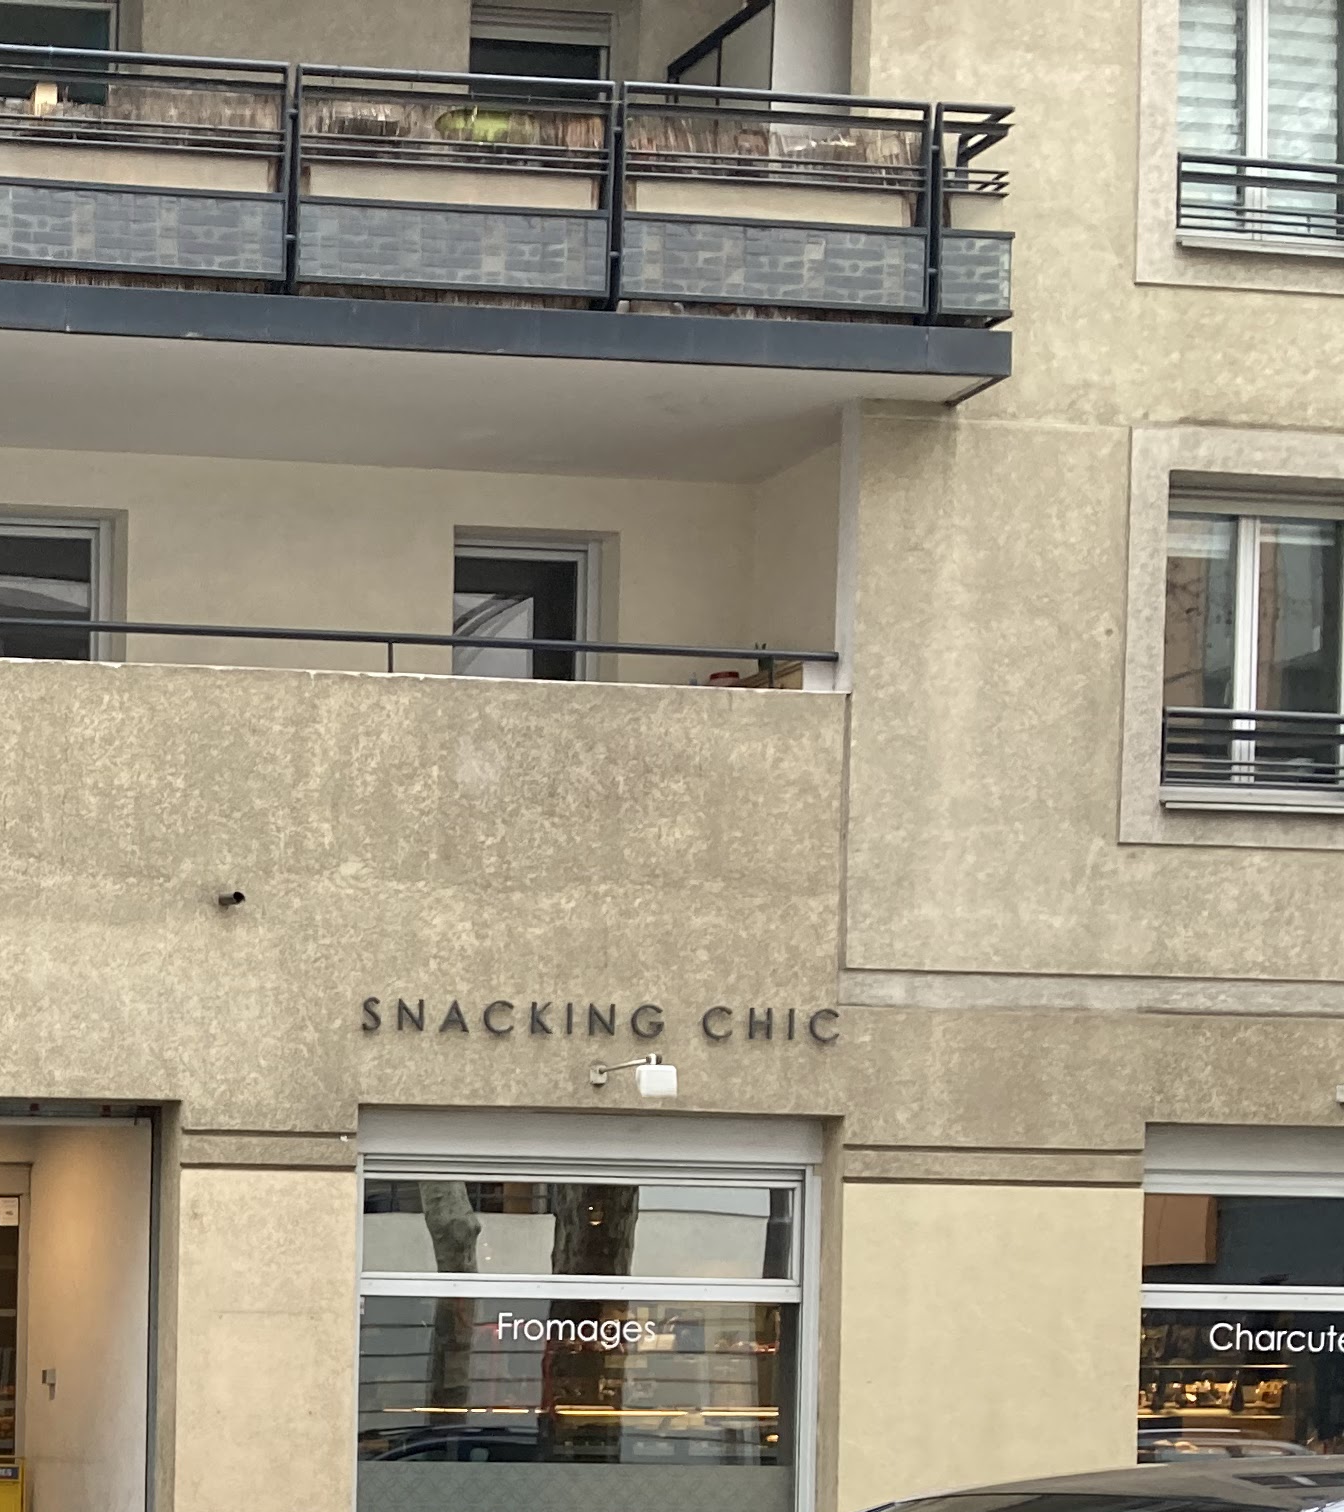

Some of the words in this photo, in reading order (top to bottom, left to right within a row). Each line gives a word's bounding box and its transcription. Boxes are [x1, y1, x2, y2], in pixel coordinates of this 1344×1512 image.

[361, 996, 666, 1040] SNACKING
[702, 1005, 841, 1043] CHIC
[497, 1312, 657, 1349] Fromages
